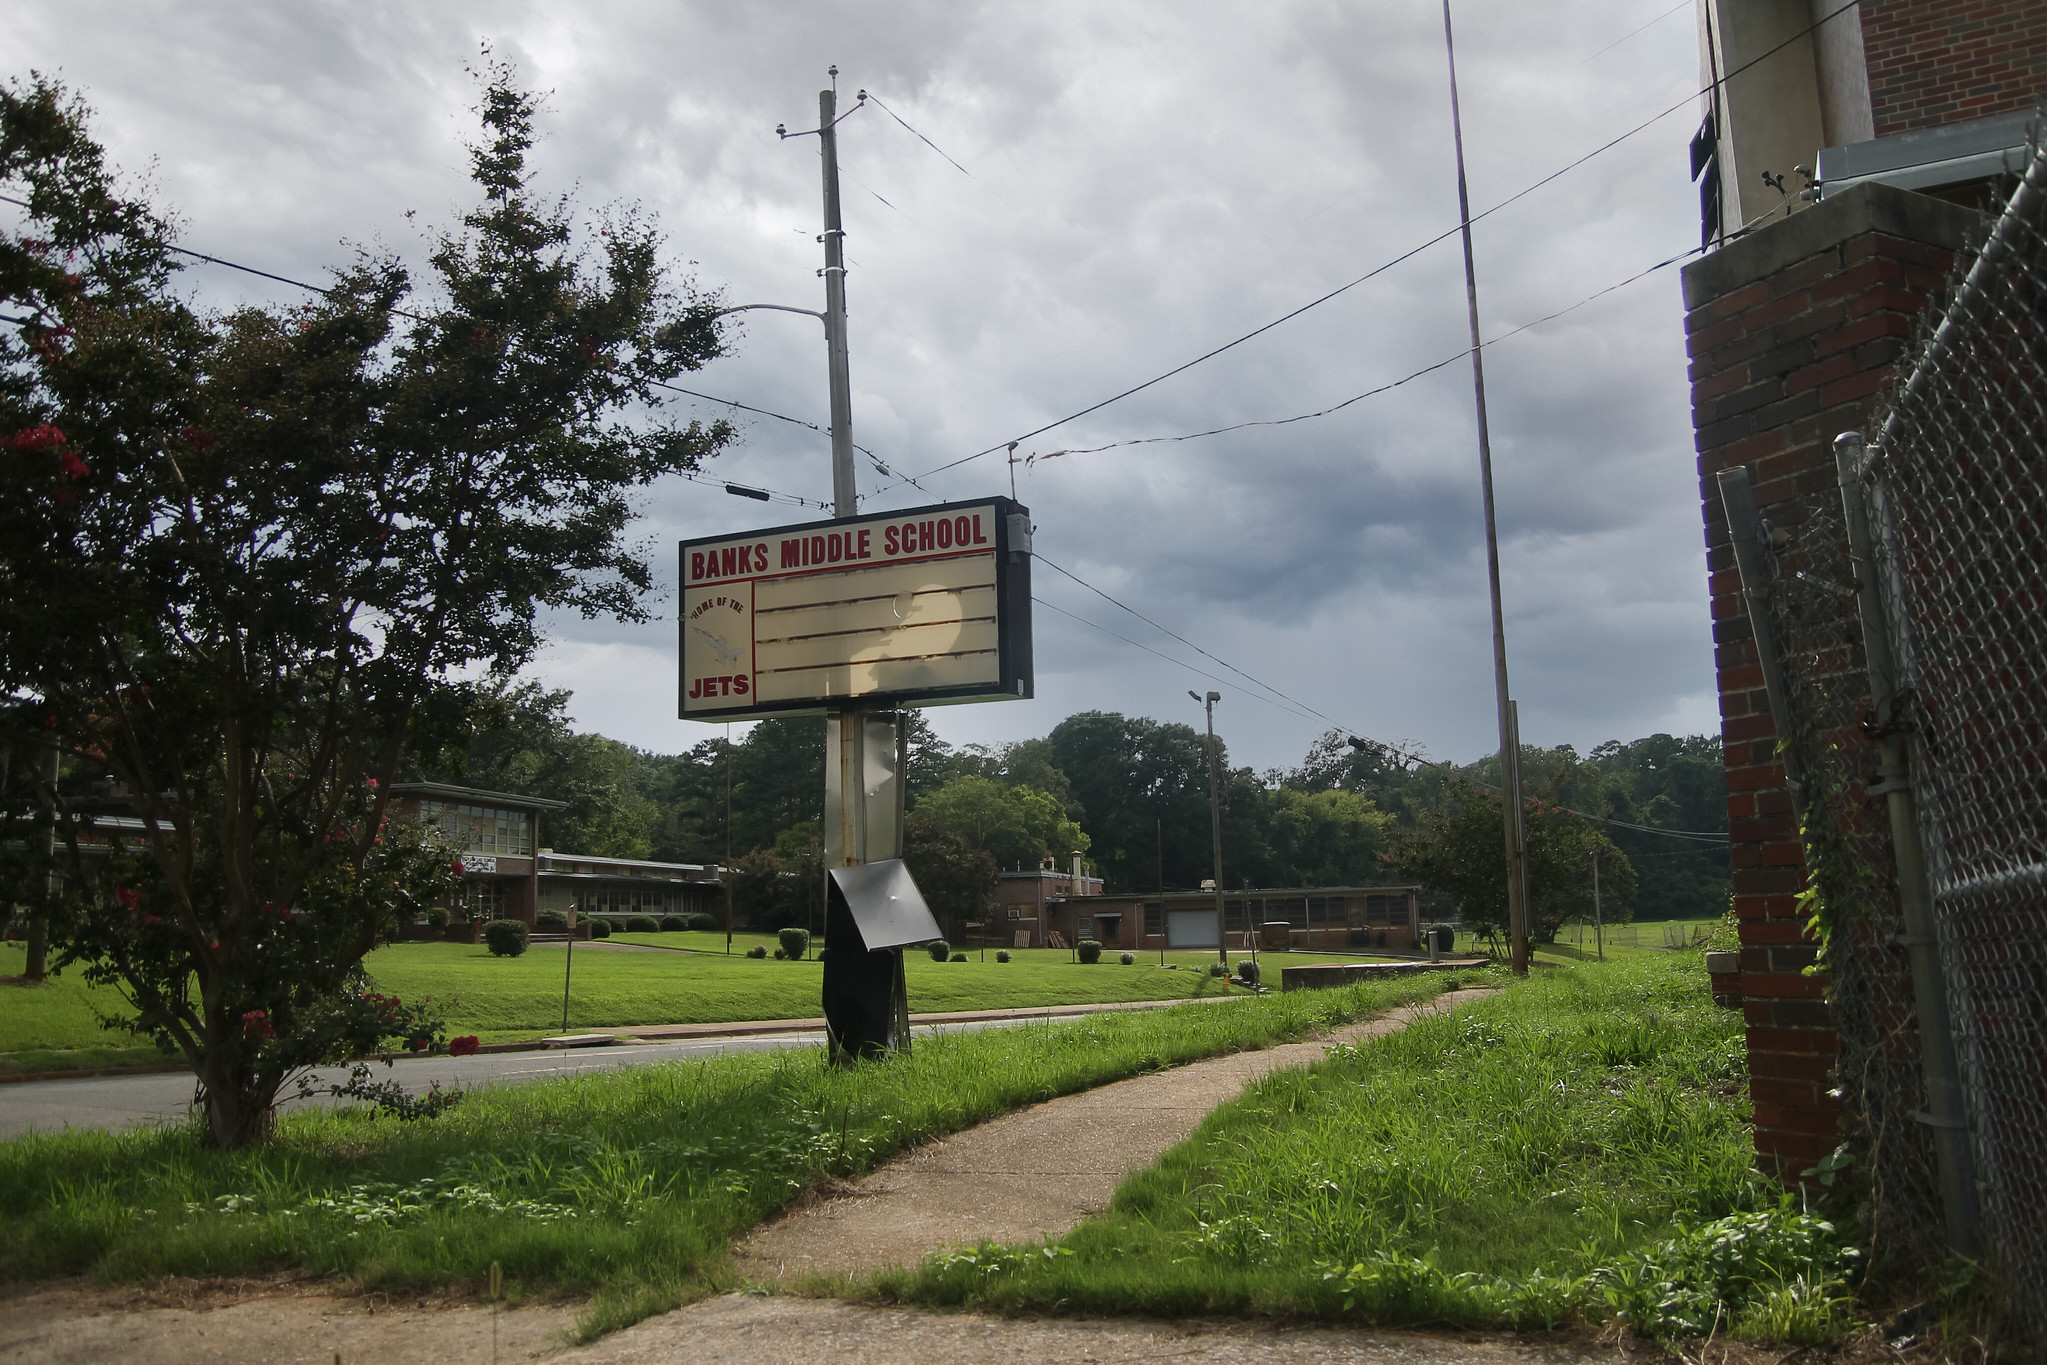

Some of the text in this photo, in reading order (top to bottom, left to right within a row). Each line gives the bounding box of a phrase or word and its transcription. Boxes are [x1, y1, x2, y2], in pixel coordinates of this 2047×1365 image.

[691, 514, 987, 581] BANKS MIDDLE SCHOOL
[690, 596, 745, 621] HOME OF THE
[688, 674, 750, 700] JETS
